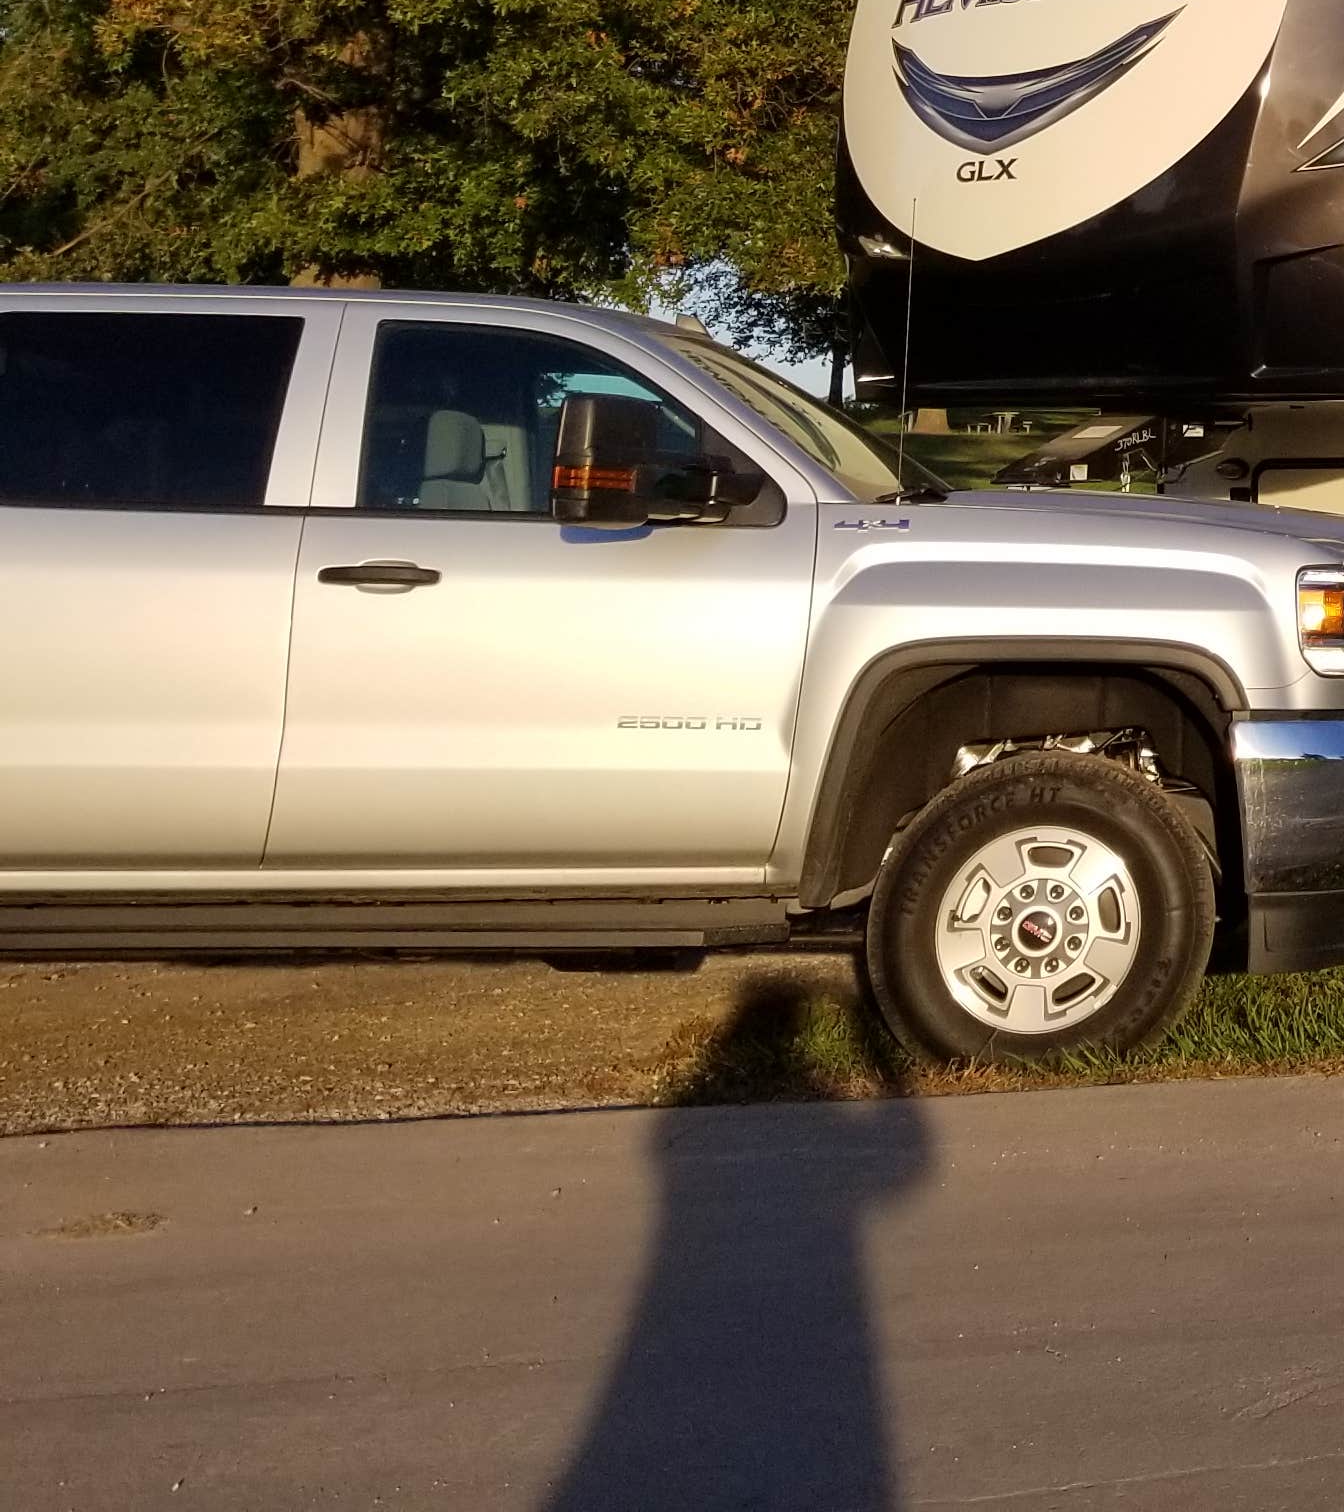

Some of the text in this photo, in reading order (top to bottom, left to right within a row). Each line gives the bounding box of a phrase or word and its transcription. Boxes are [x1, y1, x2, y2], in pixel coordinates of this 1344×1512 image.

[956, 158, 1018, 183] GLX
[616, 715, 762, 731] 2500 HD
[1022, 920, 1053, 943] GMC
